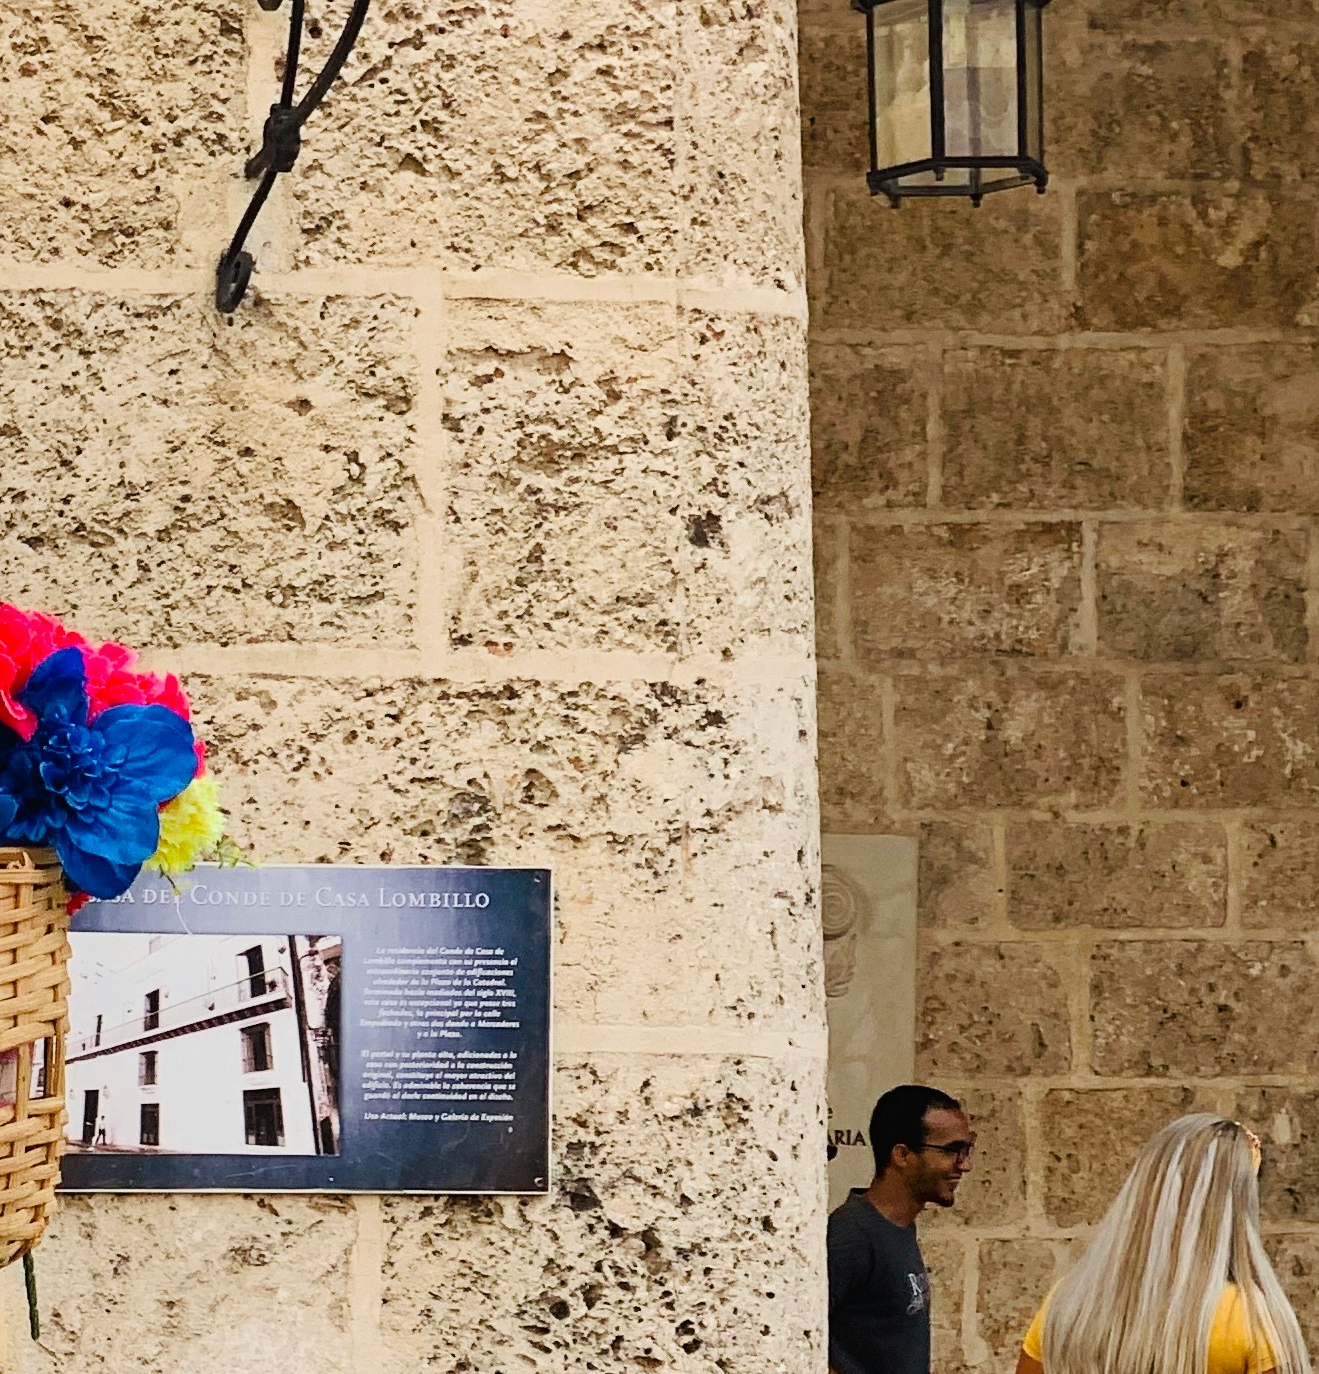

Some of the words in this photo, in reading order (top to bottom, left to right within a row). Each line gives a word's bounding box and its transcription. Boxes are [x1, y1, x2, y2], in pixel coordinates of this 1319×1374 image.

[190, 885, 271, 905] CONDE
[280, 889, 306, 906] DE
[315, 886, 370, 907] CASA
[378, 887, 490, 908] LOMBILLO
